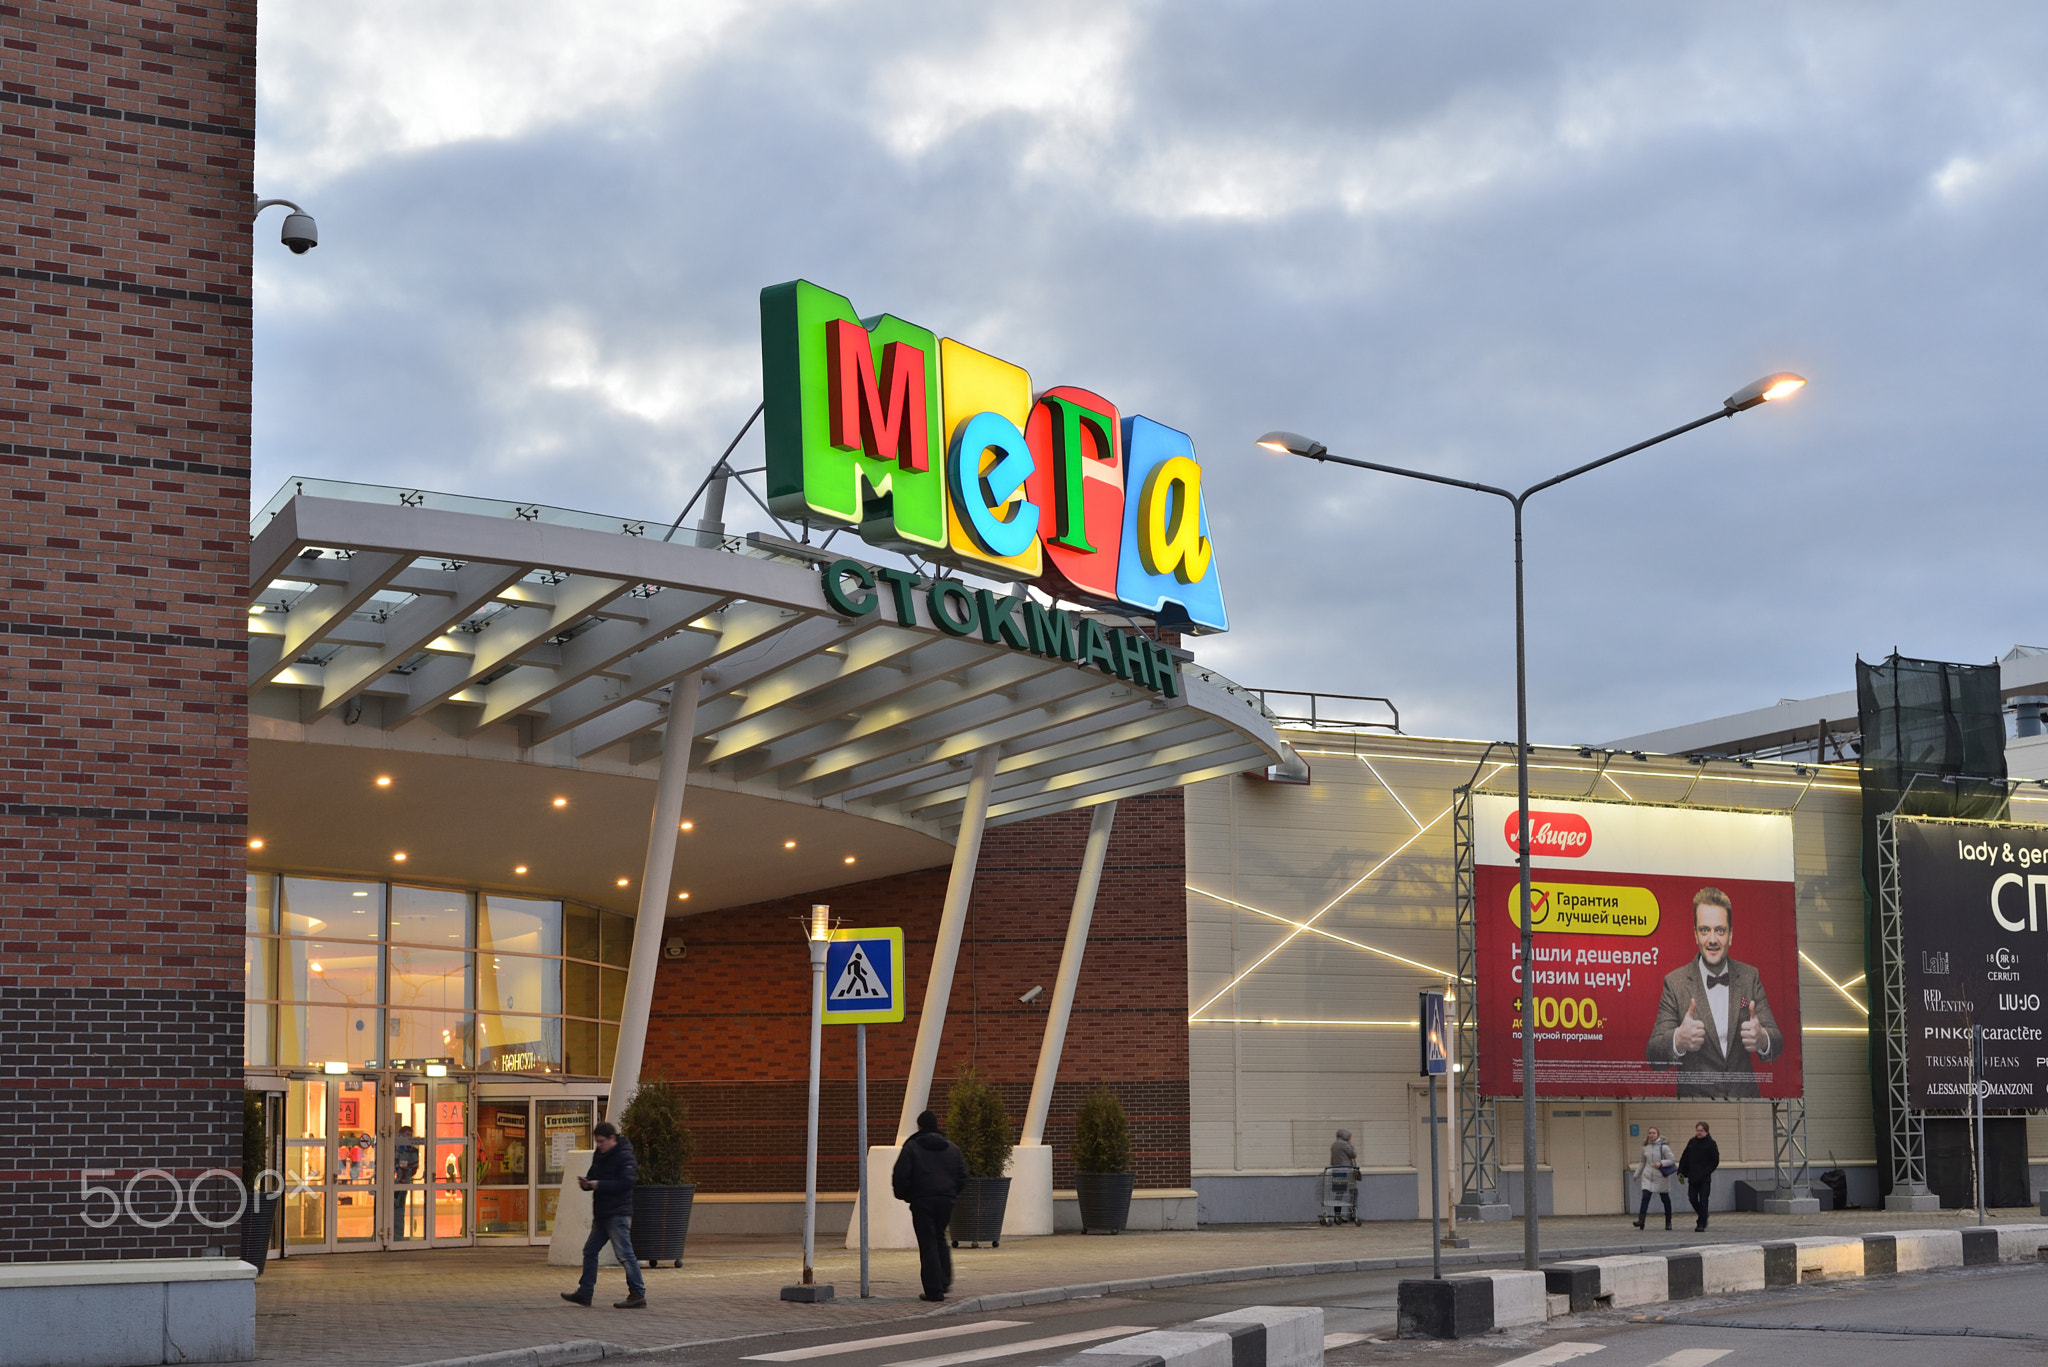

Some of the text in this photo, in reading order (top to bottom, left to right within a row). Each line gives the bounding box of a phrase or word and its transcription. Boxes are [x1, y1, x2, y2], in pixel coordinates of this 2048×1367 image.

[821, 558, 1180, 699] СТОКМАНН
[1958, 839, 1999, 867] lady
[2002, 842, 2015, 863] &
[1557, 892, 1619, 910] Гарантия
[1556, 910, 1648, 927] лучшей цены
[1511, 942, 1660, 966] Ншли дешевле?
[1511, 965, 1632, 993] Сизим цену!
[1987, 971, 2020, 982] CERRUTI
[1923, 989, 1942, 1002] RED
[1924, 1000, 1974, 1013] VALENTINO
[1533, 1031, 1560, 1042] нусной
[1561, 1033, 1604, 1043] программе
[1924, 1027, 1973, 1040] PINKO
[1989, 1056, 2020, 1068] JEANS
[441, 1104, 464, 1120] SA
[546, 1115, 590, 1126] Готовнос
